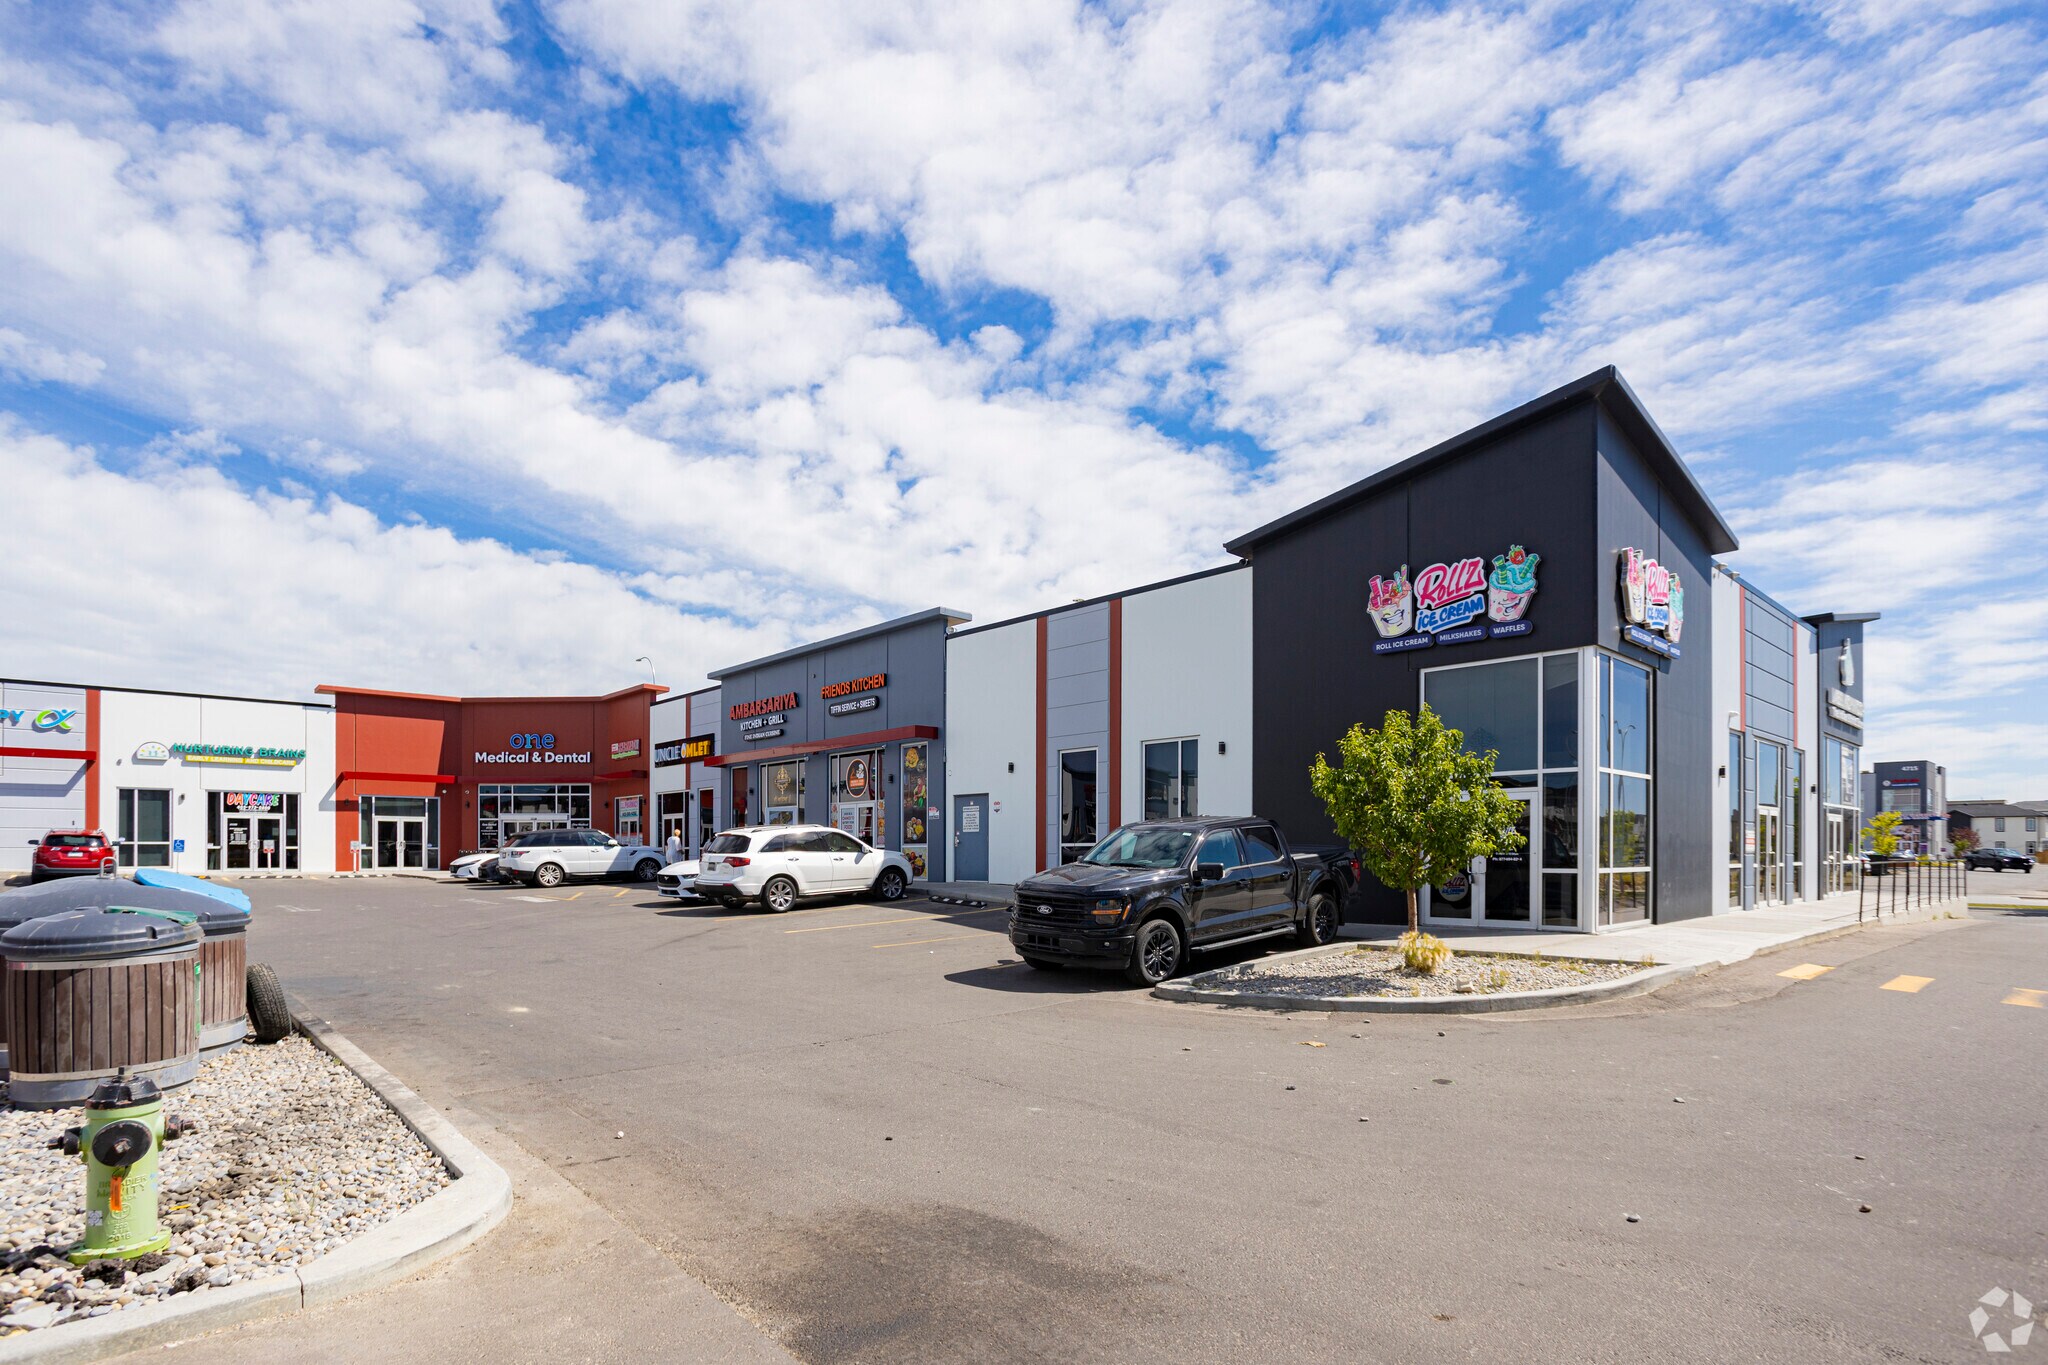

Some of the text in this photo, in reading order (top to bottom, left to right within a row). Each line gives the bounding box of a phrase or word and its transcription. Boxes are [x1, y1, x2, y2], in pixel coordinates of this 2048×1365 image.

[1439, 595, 1484, 620] CREAM
[1439, 629, 1482, 641] MILKSHAKES
[1493, 624, 1526, 634] WAFFLES
[1375, 636, 1429, 651] ROLL ICE CREAM
[821, 672, 886, 699] FRIENDS KITCHEN
[729, 691, 797, 720] AMBARSARIYA
[841, 701, 857, 712] SERVICE
[860, 698, 876, 709] SWEETS
[740, 717, 763, 732] KITCHEN
[768, 714, 784, 726] GRILL
[509, 733, 555, 749] one
[172, 742, 307, 759] NURTURING BRAINS
[475, 751, 591, 763] Medical & Dental
[655, 745, 681, 762] UNCLE
[226, 792, 280, 807] DAYCARE
